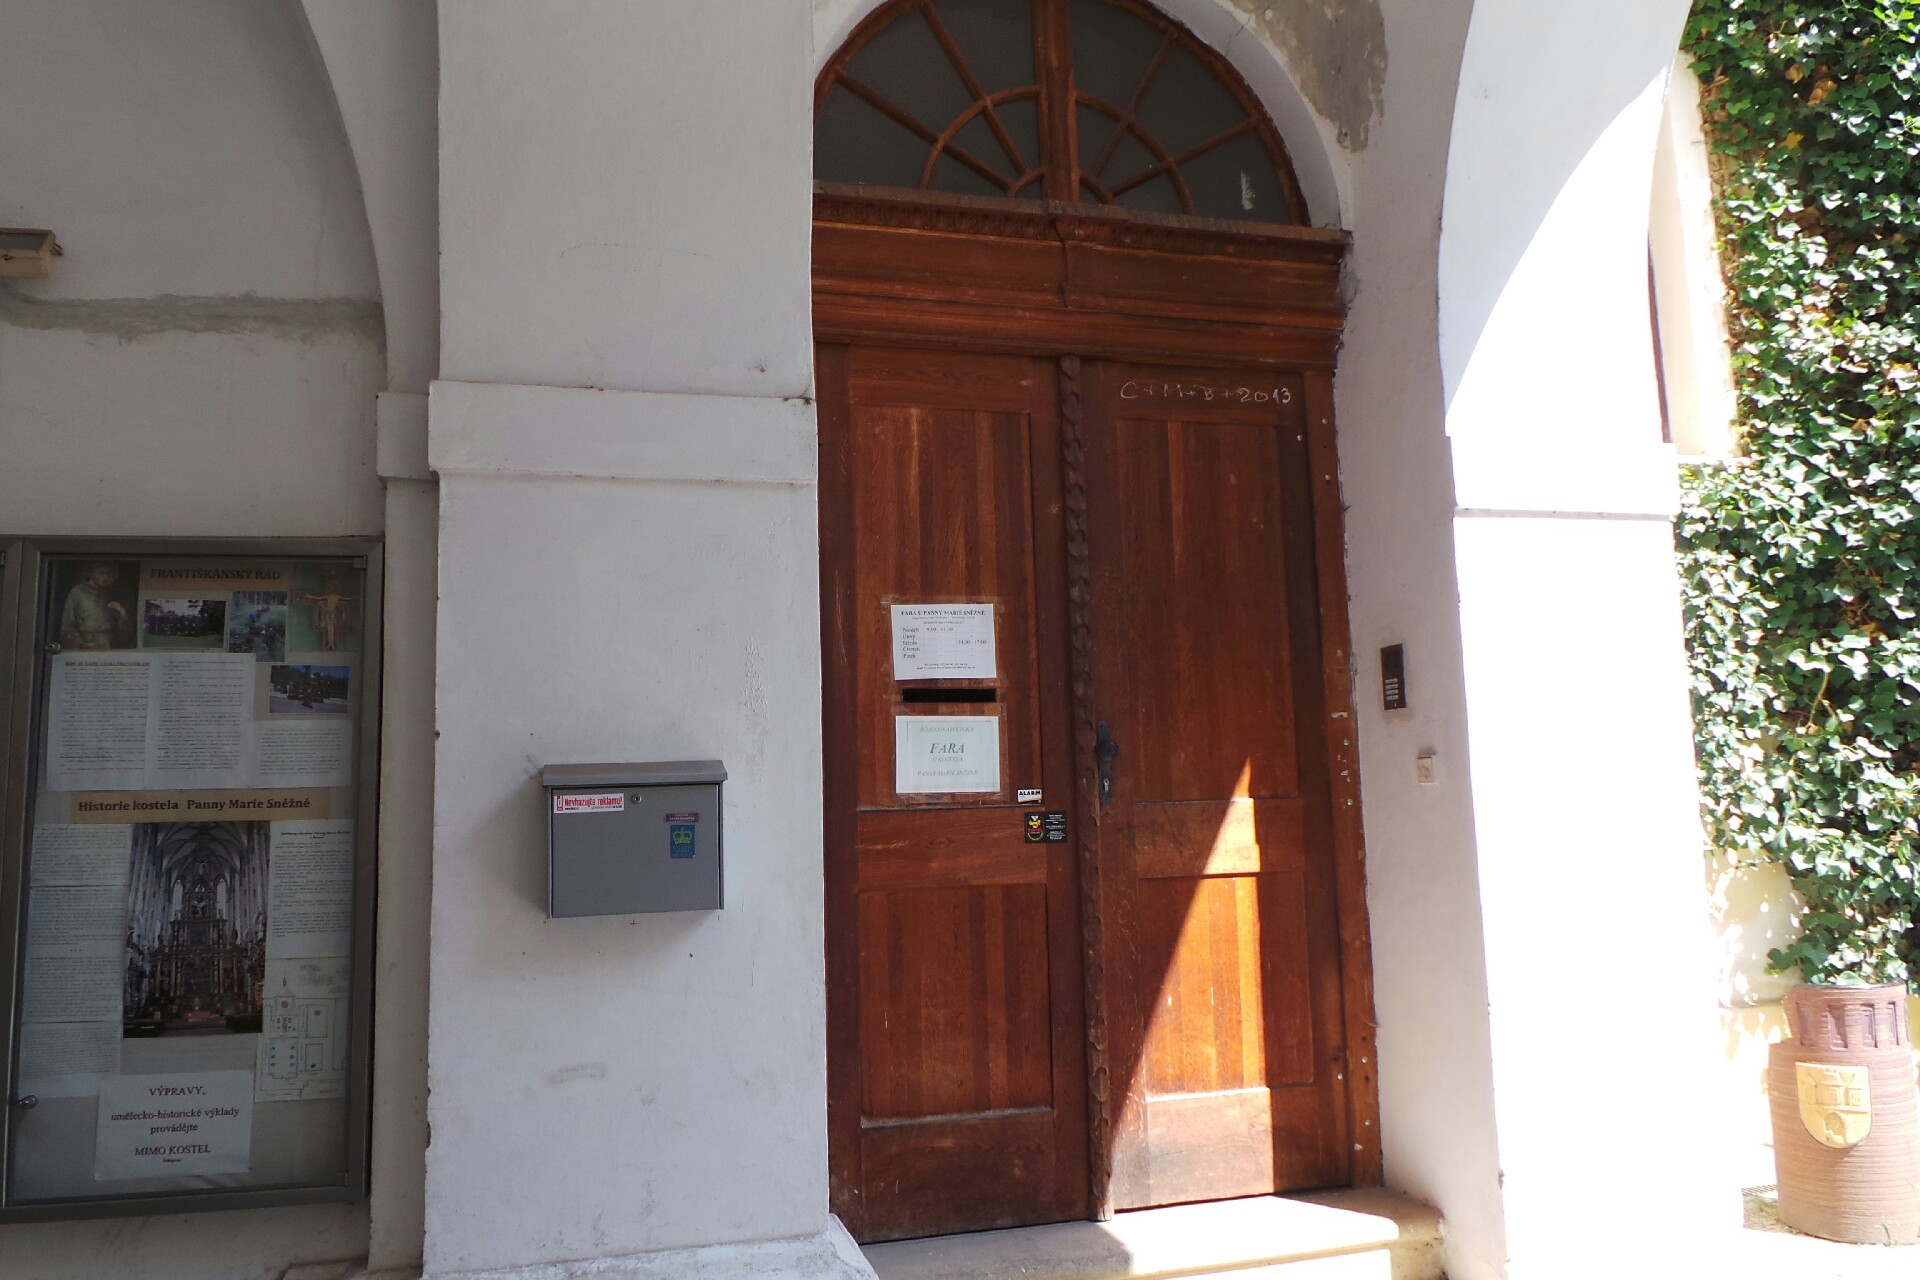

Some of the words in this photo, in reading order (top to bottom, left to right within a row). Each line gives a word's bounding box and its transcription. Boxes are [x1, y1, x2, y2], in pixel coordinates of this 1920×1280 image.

[150, 567, 252, 579] FRANTIŠKÁNSKÝ
[255, 568, 281, 580] ŘÁD
[929, 742, 965, 754] FARA
[79, 800, 130, 812] Historie
[133, 800, 179, 811] kostela
[187, 799, 226, 813] Panny
[228, 798, 264, 809] Marie
[266, 797, 311, 809] Sněžné
[564, 797, 596, 808] Nevhazujte
[598, 796, 623, 806] reklamu!
[111, 1107, 202, 1121] umělecko-historické
[204, 1107, 240, 1119] výklady
[150, 1122, 198, 1136] provádějte
[134, 1146, 166, 1156] MIMO
[168, 1144, 211, 1155] KOSTEL
